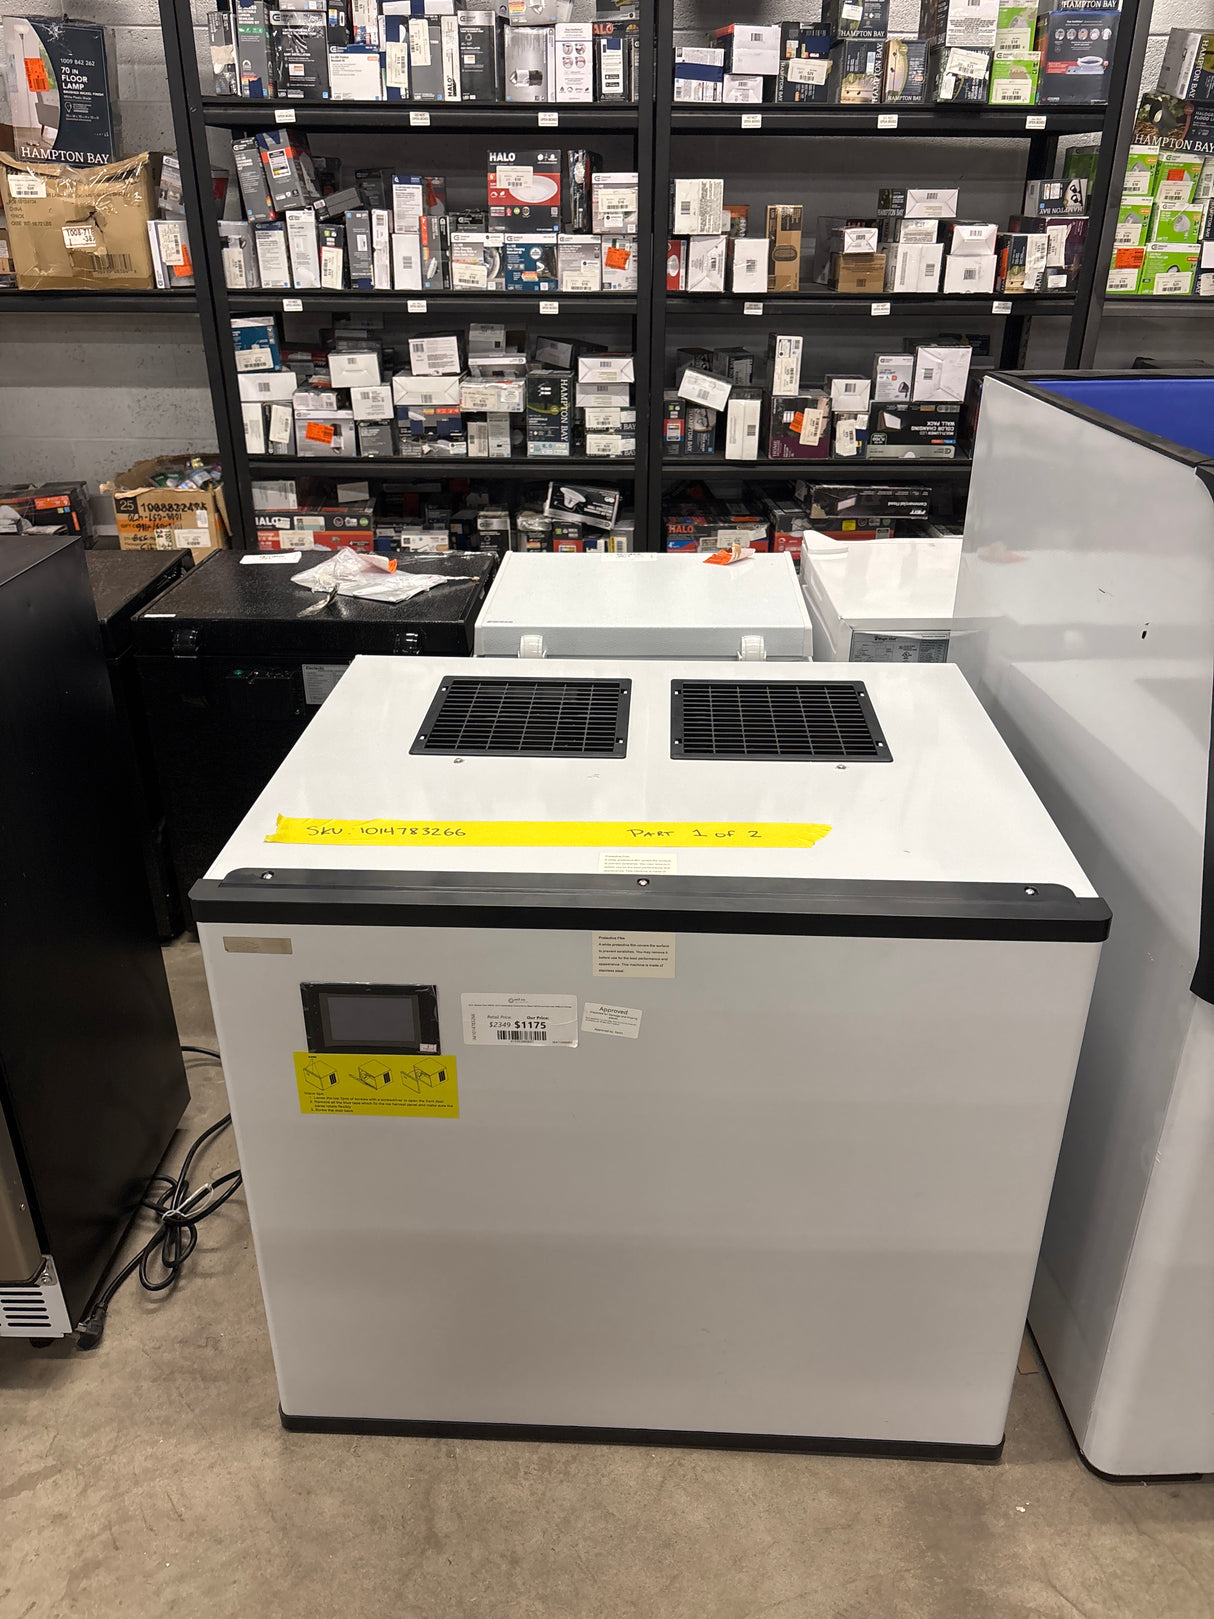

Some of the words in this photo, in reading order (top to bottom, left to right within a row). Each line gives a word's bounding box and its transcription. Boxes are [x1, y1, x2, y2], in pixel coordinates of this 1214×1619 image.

[1062, 0, 1100, 9] HAMPTON
[1101, 0, 1118, 8] BAY
[593, 23, 614, 35] ALO
[1194, 39, 1209, 81] HAMPTON
[61, 74, 88, 83] FLOOR
[872, 63, 882, 103] HAMPTON
[62, 82, 84, 90] LAMP
[1189, 83, 1198, 98] BAY
[1134, 134, 1192, 150] HAMPTON
[1193, 141, 1214, 153] BAY
[21, 146, 84, 163] HAMPTON
[86, 153, 110, 165] BAY
[489, 152, 516, 162] HALO
[1052, 206, 1082, 214] HAMPTON
[560, 379, 569, 424] HAMPTON
[560, 425, 569, 442] BAY
[120, 500, 135, 511] 25
[668, 524, 694, 534] HALO
[360, 826, 466, 837] 1014783266
[693, 829, 708, 837] 1
[747, 830, 762, 838] 2
[599, 1006, 629, 1015] Approved
[489, 1021, 511, 1029] $2349
[514, 1020, 547, 1030] $1175
